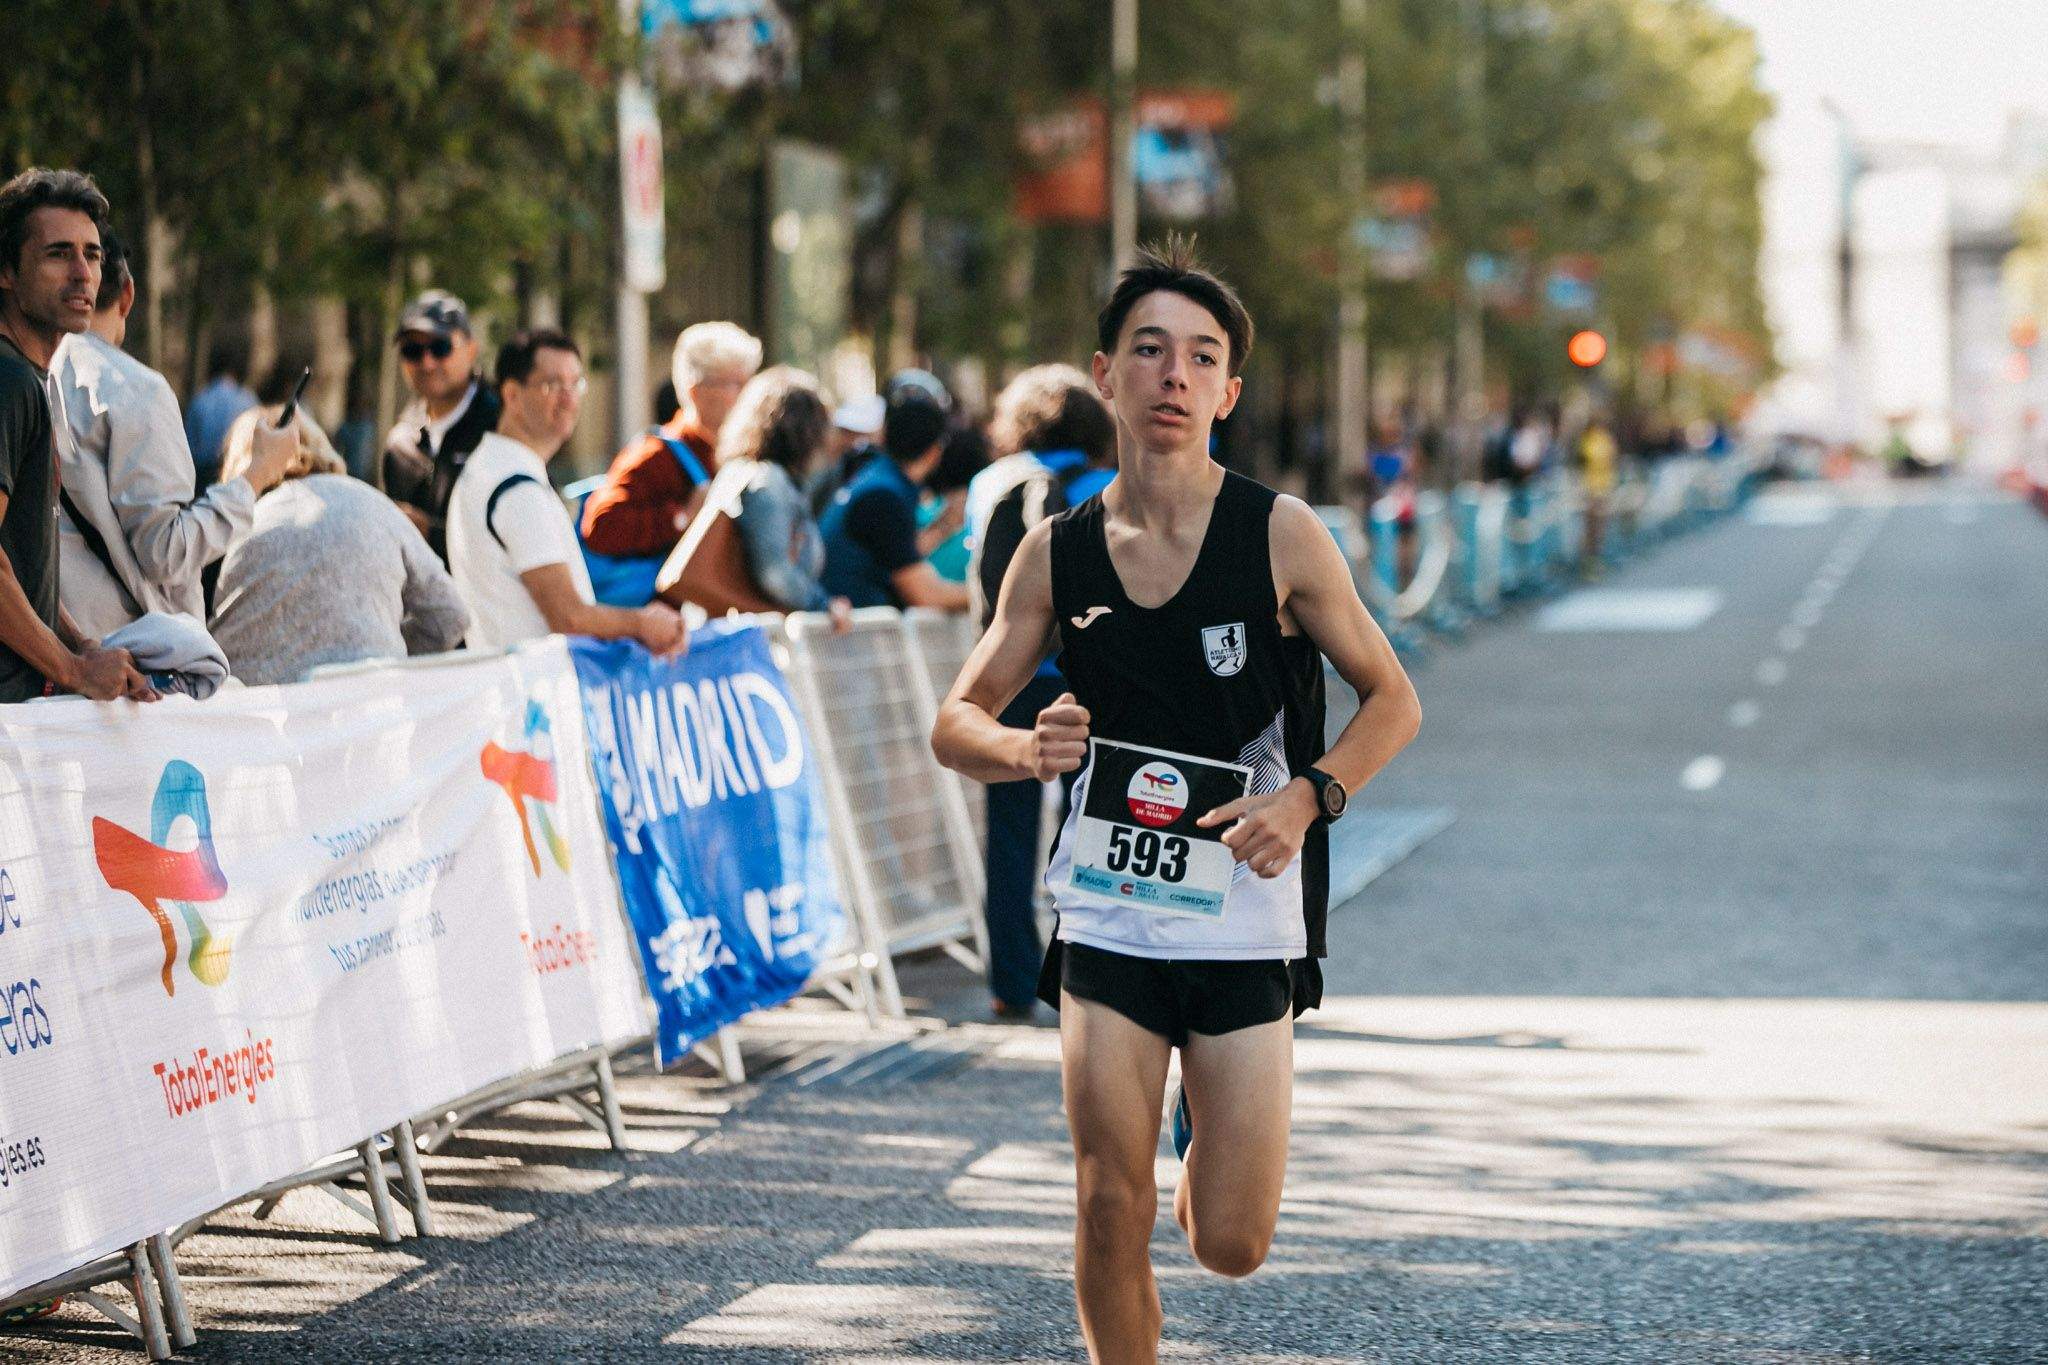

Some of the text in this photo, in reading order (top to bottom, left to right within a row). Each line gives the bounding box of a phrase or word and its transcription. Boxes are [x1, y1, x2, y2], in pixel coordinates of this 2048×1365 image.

[627, 672, 803, 822] MADRID
[1145, 803, 1165, 812] MILLA
[1146, 810, 1172, 820] MADRID
[1107, 826, 1190, 883] 593
[1084, 875, 1112, 889] MADRID
[1170, 894, 1212, 906] CORREDOR
[153, 1028, 275, 1119] TotalEnergies
